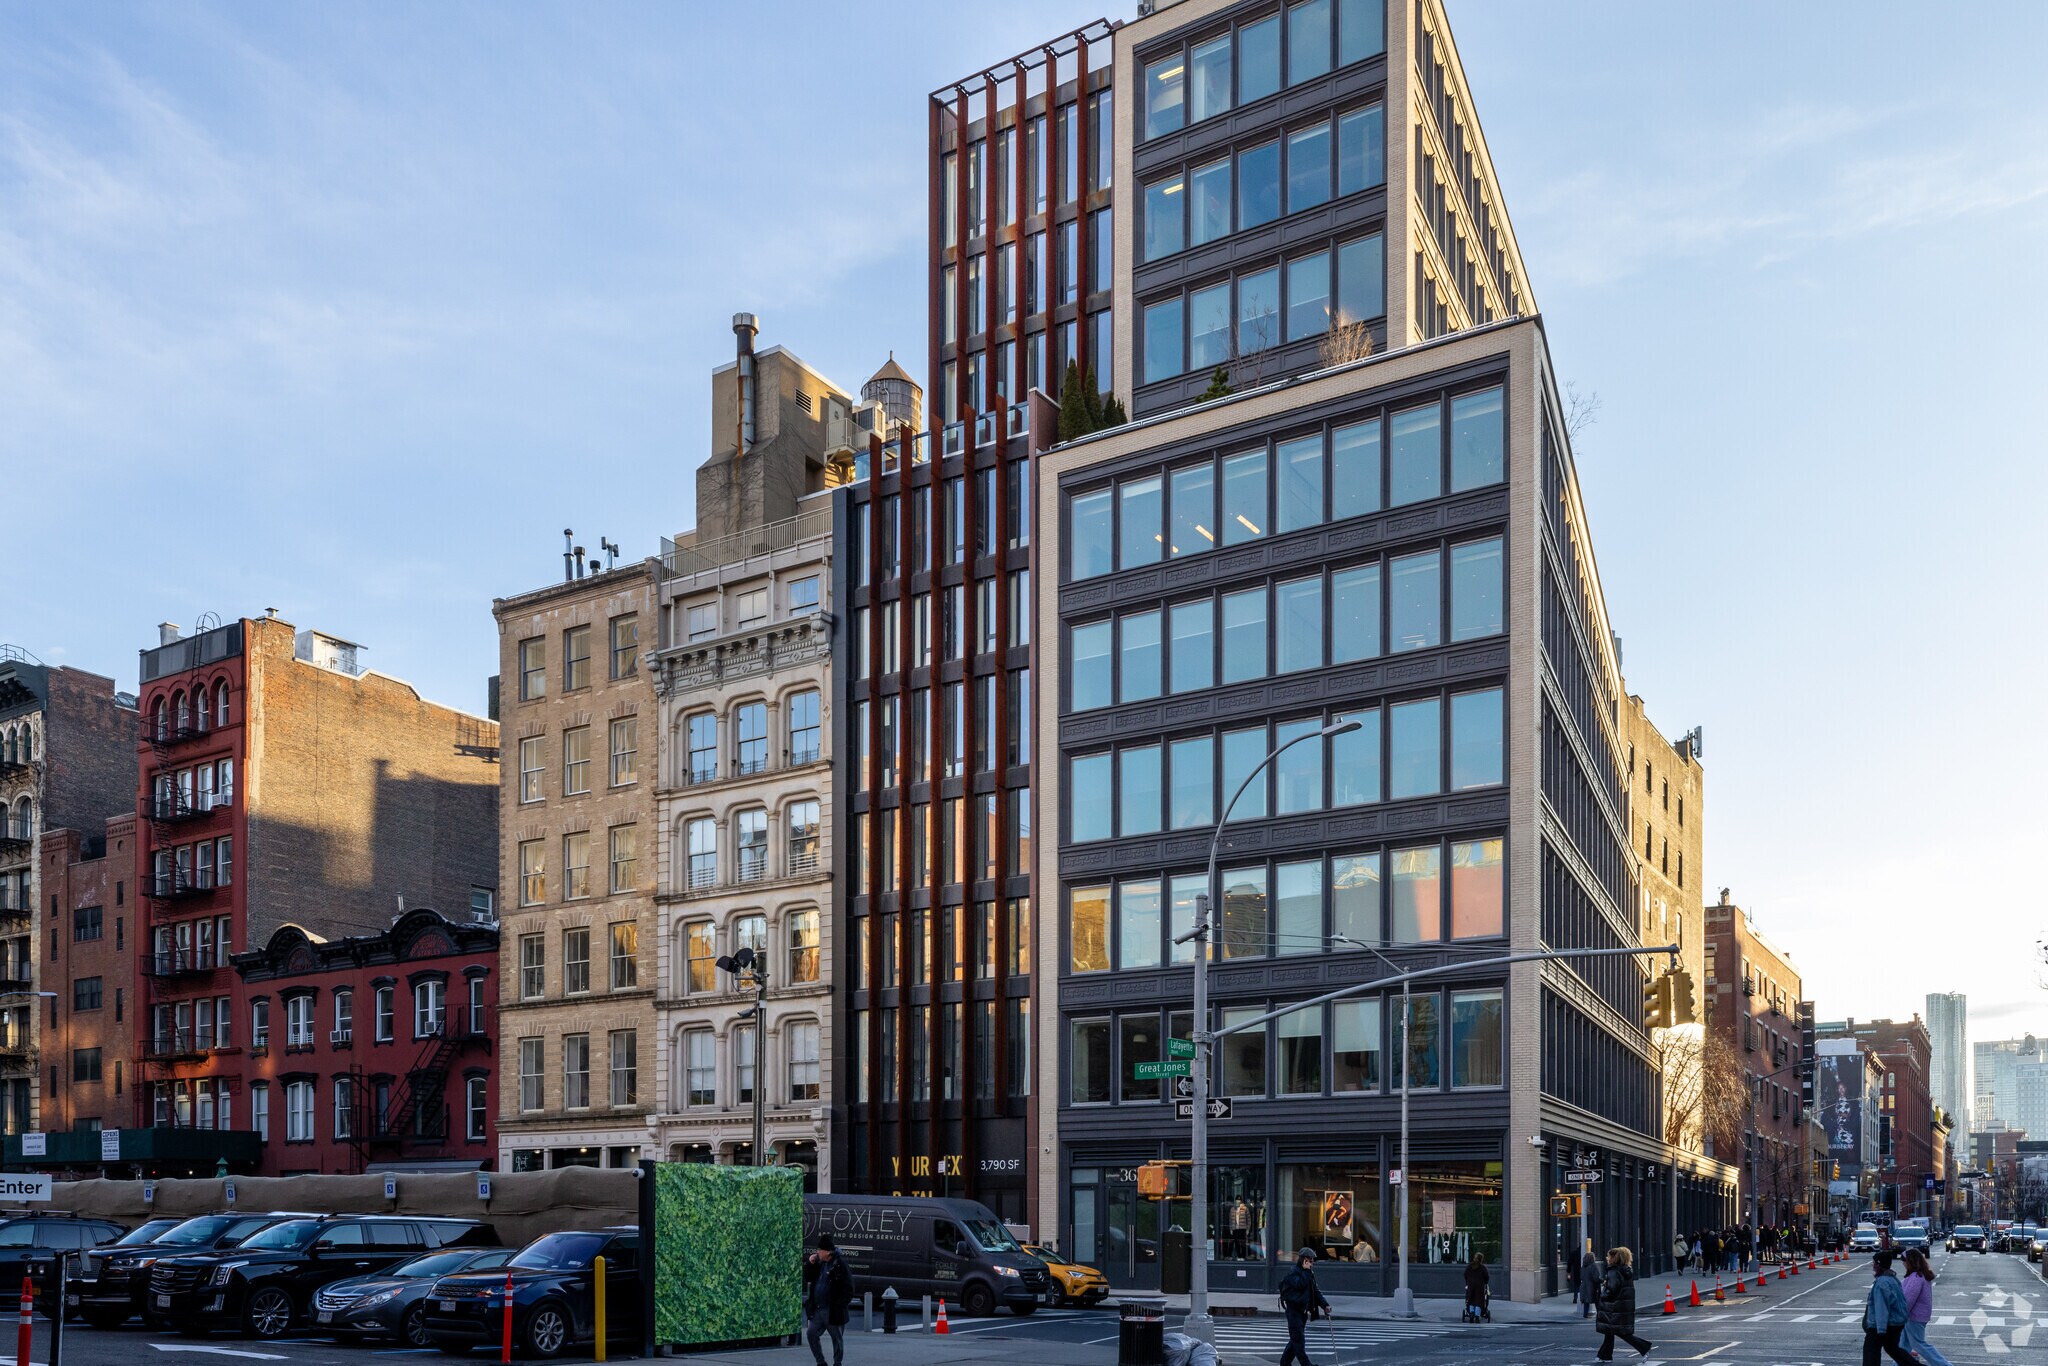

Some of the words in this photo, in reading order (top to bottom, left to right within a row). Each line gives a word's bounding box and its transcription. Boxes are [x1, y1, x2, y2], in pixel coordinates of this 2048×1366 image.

[1170, 1040, 1193, 1052] Lafayette
[1139, 1064, 1160, 1073] Great
[1163, 1063, 1186, 1072] Jones
[1181, 1081, 1191, 1090] ONE
[1206, 1104, 1224, 1113] WAY
[891, 1155, 930, 1177] YUR
[980, 1159, 1006, 1171] 3,790
[1007, 1159, 1020, 1170] SF
[1120, 1168, 1138, 1182] 36
[0, 1179, 43, 1194] Enter
[818, 1207, 912, 1233] FOXLEY
